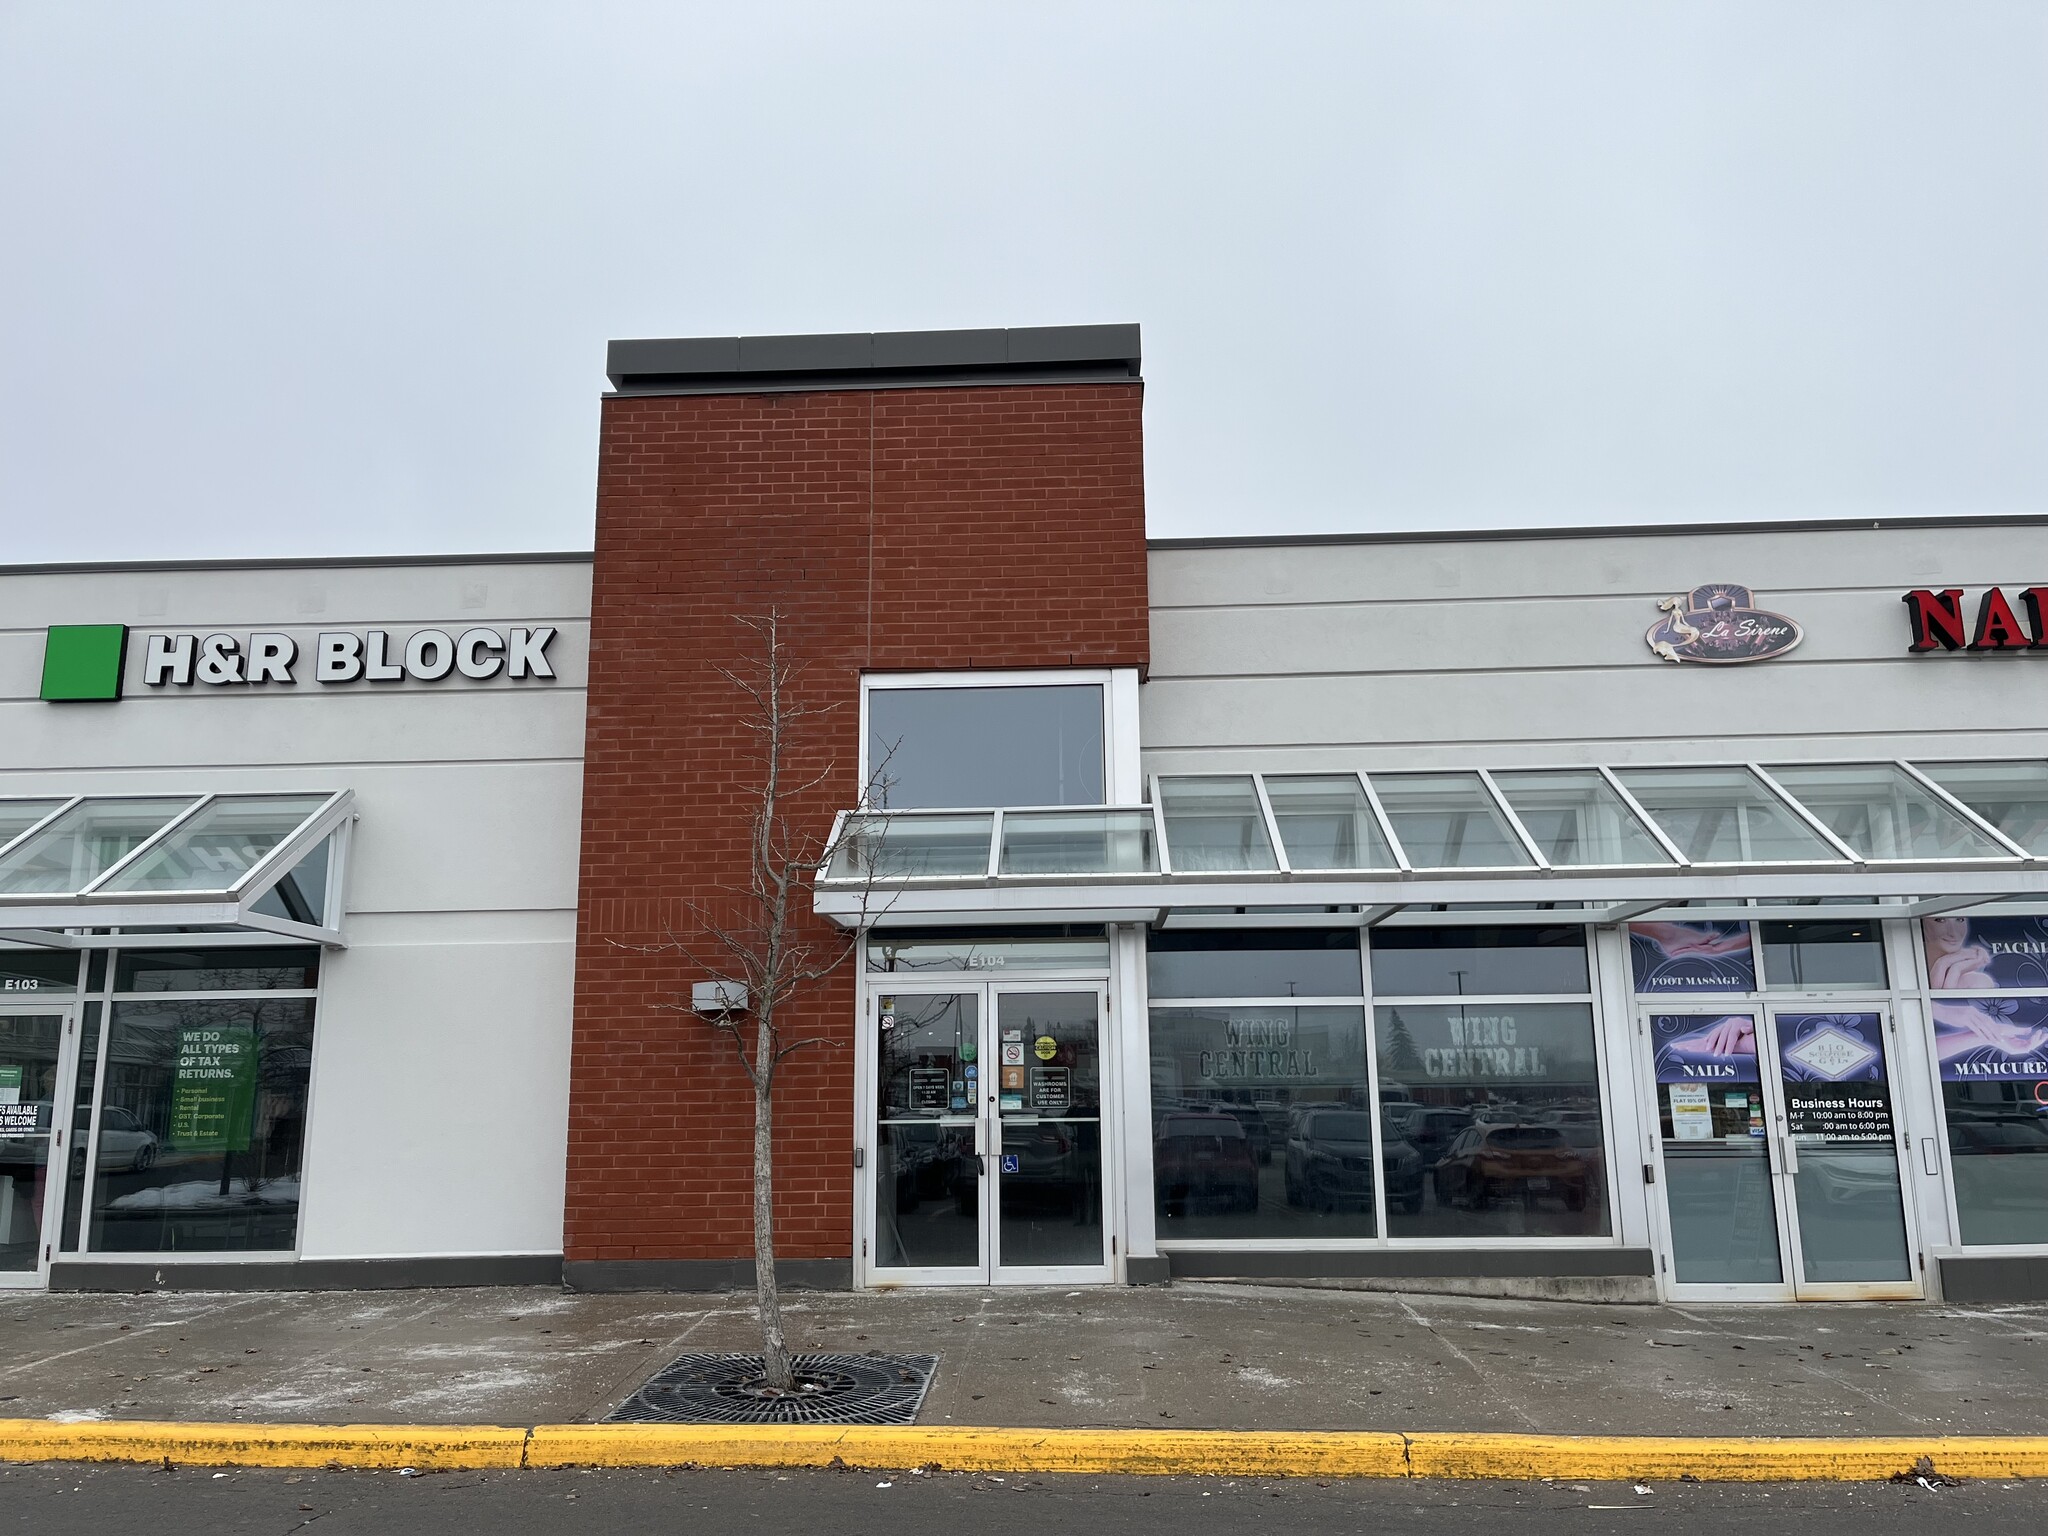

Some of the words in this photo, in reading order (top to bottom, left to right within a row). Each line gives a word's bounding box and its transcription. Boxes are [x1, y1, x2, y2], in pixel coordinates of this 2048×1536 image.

[1702, 621, 1730, 638] La
[1735, 619, 1788, 636] Sirene
[144, 633, 299, 686] H&R
[316, 628, 558, 684] BLOCK
[969, 956, 1005, 967] E104
[5, 979, 38, 990] E103
[1652, 977, 1683, 986] FOOT
[1686, 976, 1740, 985] MASSAGE
[183, 1032, 201, 1042] WE
[202, 1031, 220, 1042] DO
[1222, 1018, 1290, 1048] WING
[1447, 1016, 1517, 1046] WING
[181, 1044, 202, 1054] ALL
[204, 1043, 240, 1054] TYPES
[180, 1056, 197, 1067] OF
[198, 1056, 221, 1066] TAX
[1199, 1049, 1318, 1079] CENTRAL
[1424, 1047, 1547, 1078] CENTRAL
[178, 1068, 235, 1079] RETURNS.
[1682, 1064, 1736, 1077] NAILS
[1954, 1061, 2047, 1076] MANICURE
[1791, 1098, 1846, 1109] Business
[1848, 1097, 1884, 1108] Hours
[6, 1105, 38, 1115] AVAILABLE
[1789, 1111, 1805, 1120] M-F
[1812, 1111, 1833, 1119] 10:00
[1847, 1111, 1856, 1119] to
[1857, 1111, 1874, 1119] 8:00
[1875, 1112, 1888, 1120] pm
[4, 1115, 37, 1126] WELCOME
[1790, 1122, 1804, 1130] Sat
[1849, 1122, 1857, 1130] to
[1858, 1122, 1875, 1130] 6:00
[1876, 1123, 1890, 1131] pm
[1815, 1133, 1836, 1141] 11:00
[1851, 1133, 1860, 1141] to
[1860, 1132, 1877, 1140] 5:00
[1878, 1133, 1892, 1142] pm
